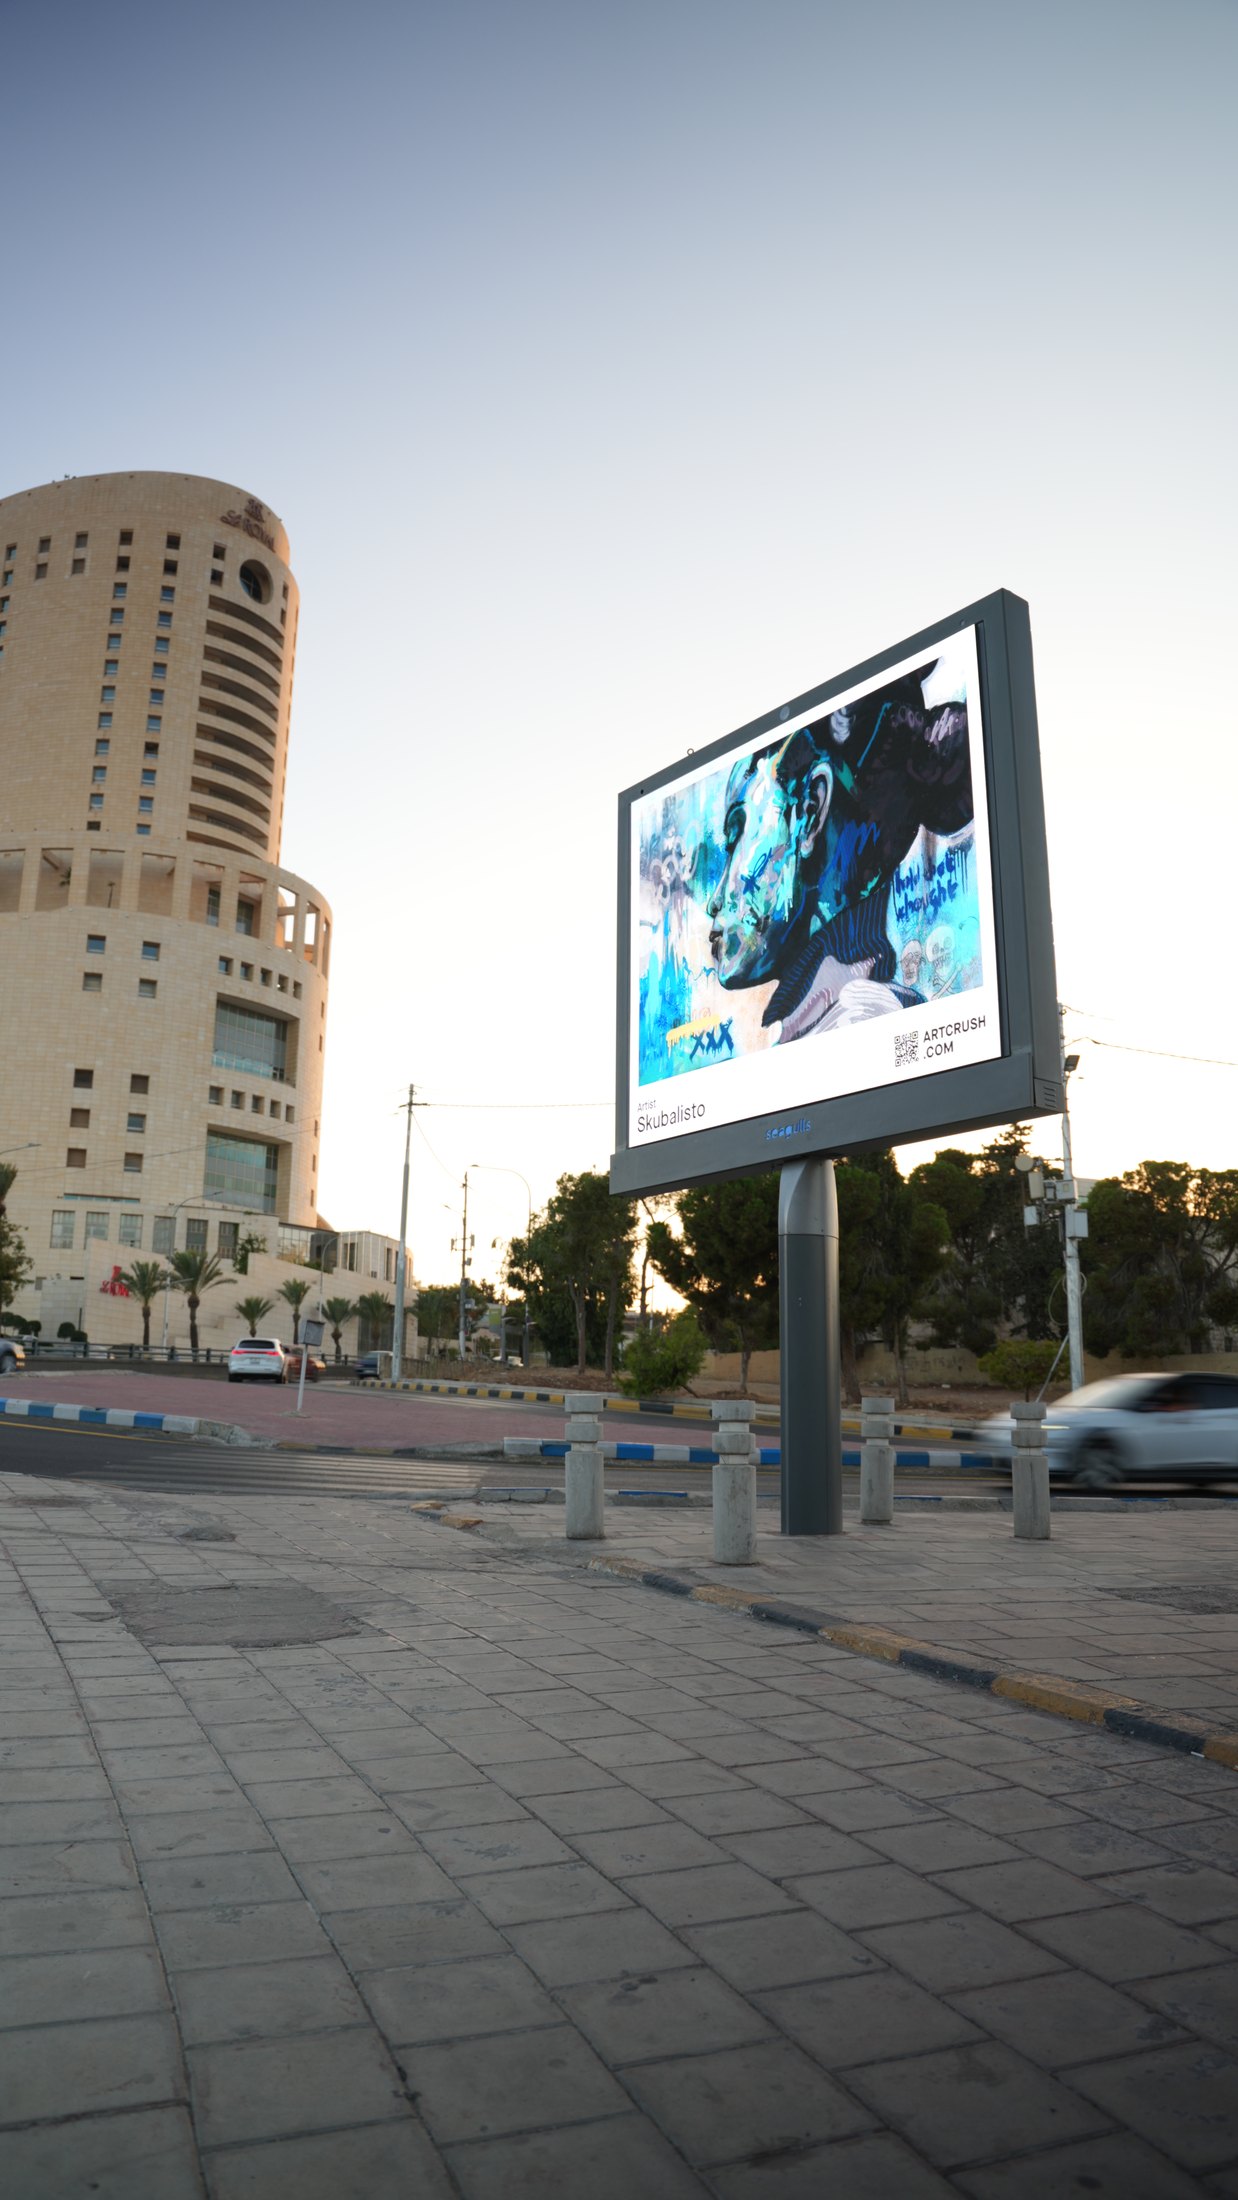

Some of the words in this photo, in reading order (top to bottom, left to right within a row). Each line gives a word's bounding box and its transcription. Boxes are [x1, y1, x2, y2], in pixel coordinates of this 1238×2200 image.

[923, 1015, 986, 1043] ARTCRUSH
[923, 1041, 955, 1060] .COM
[637, 1099, 656, 1112] Artist
[637, 1103, 706, 1133] Skubalisto
